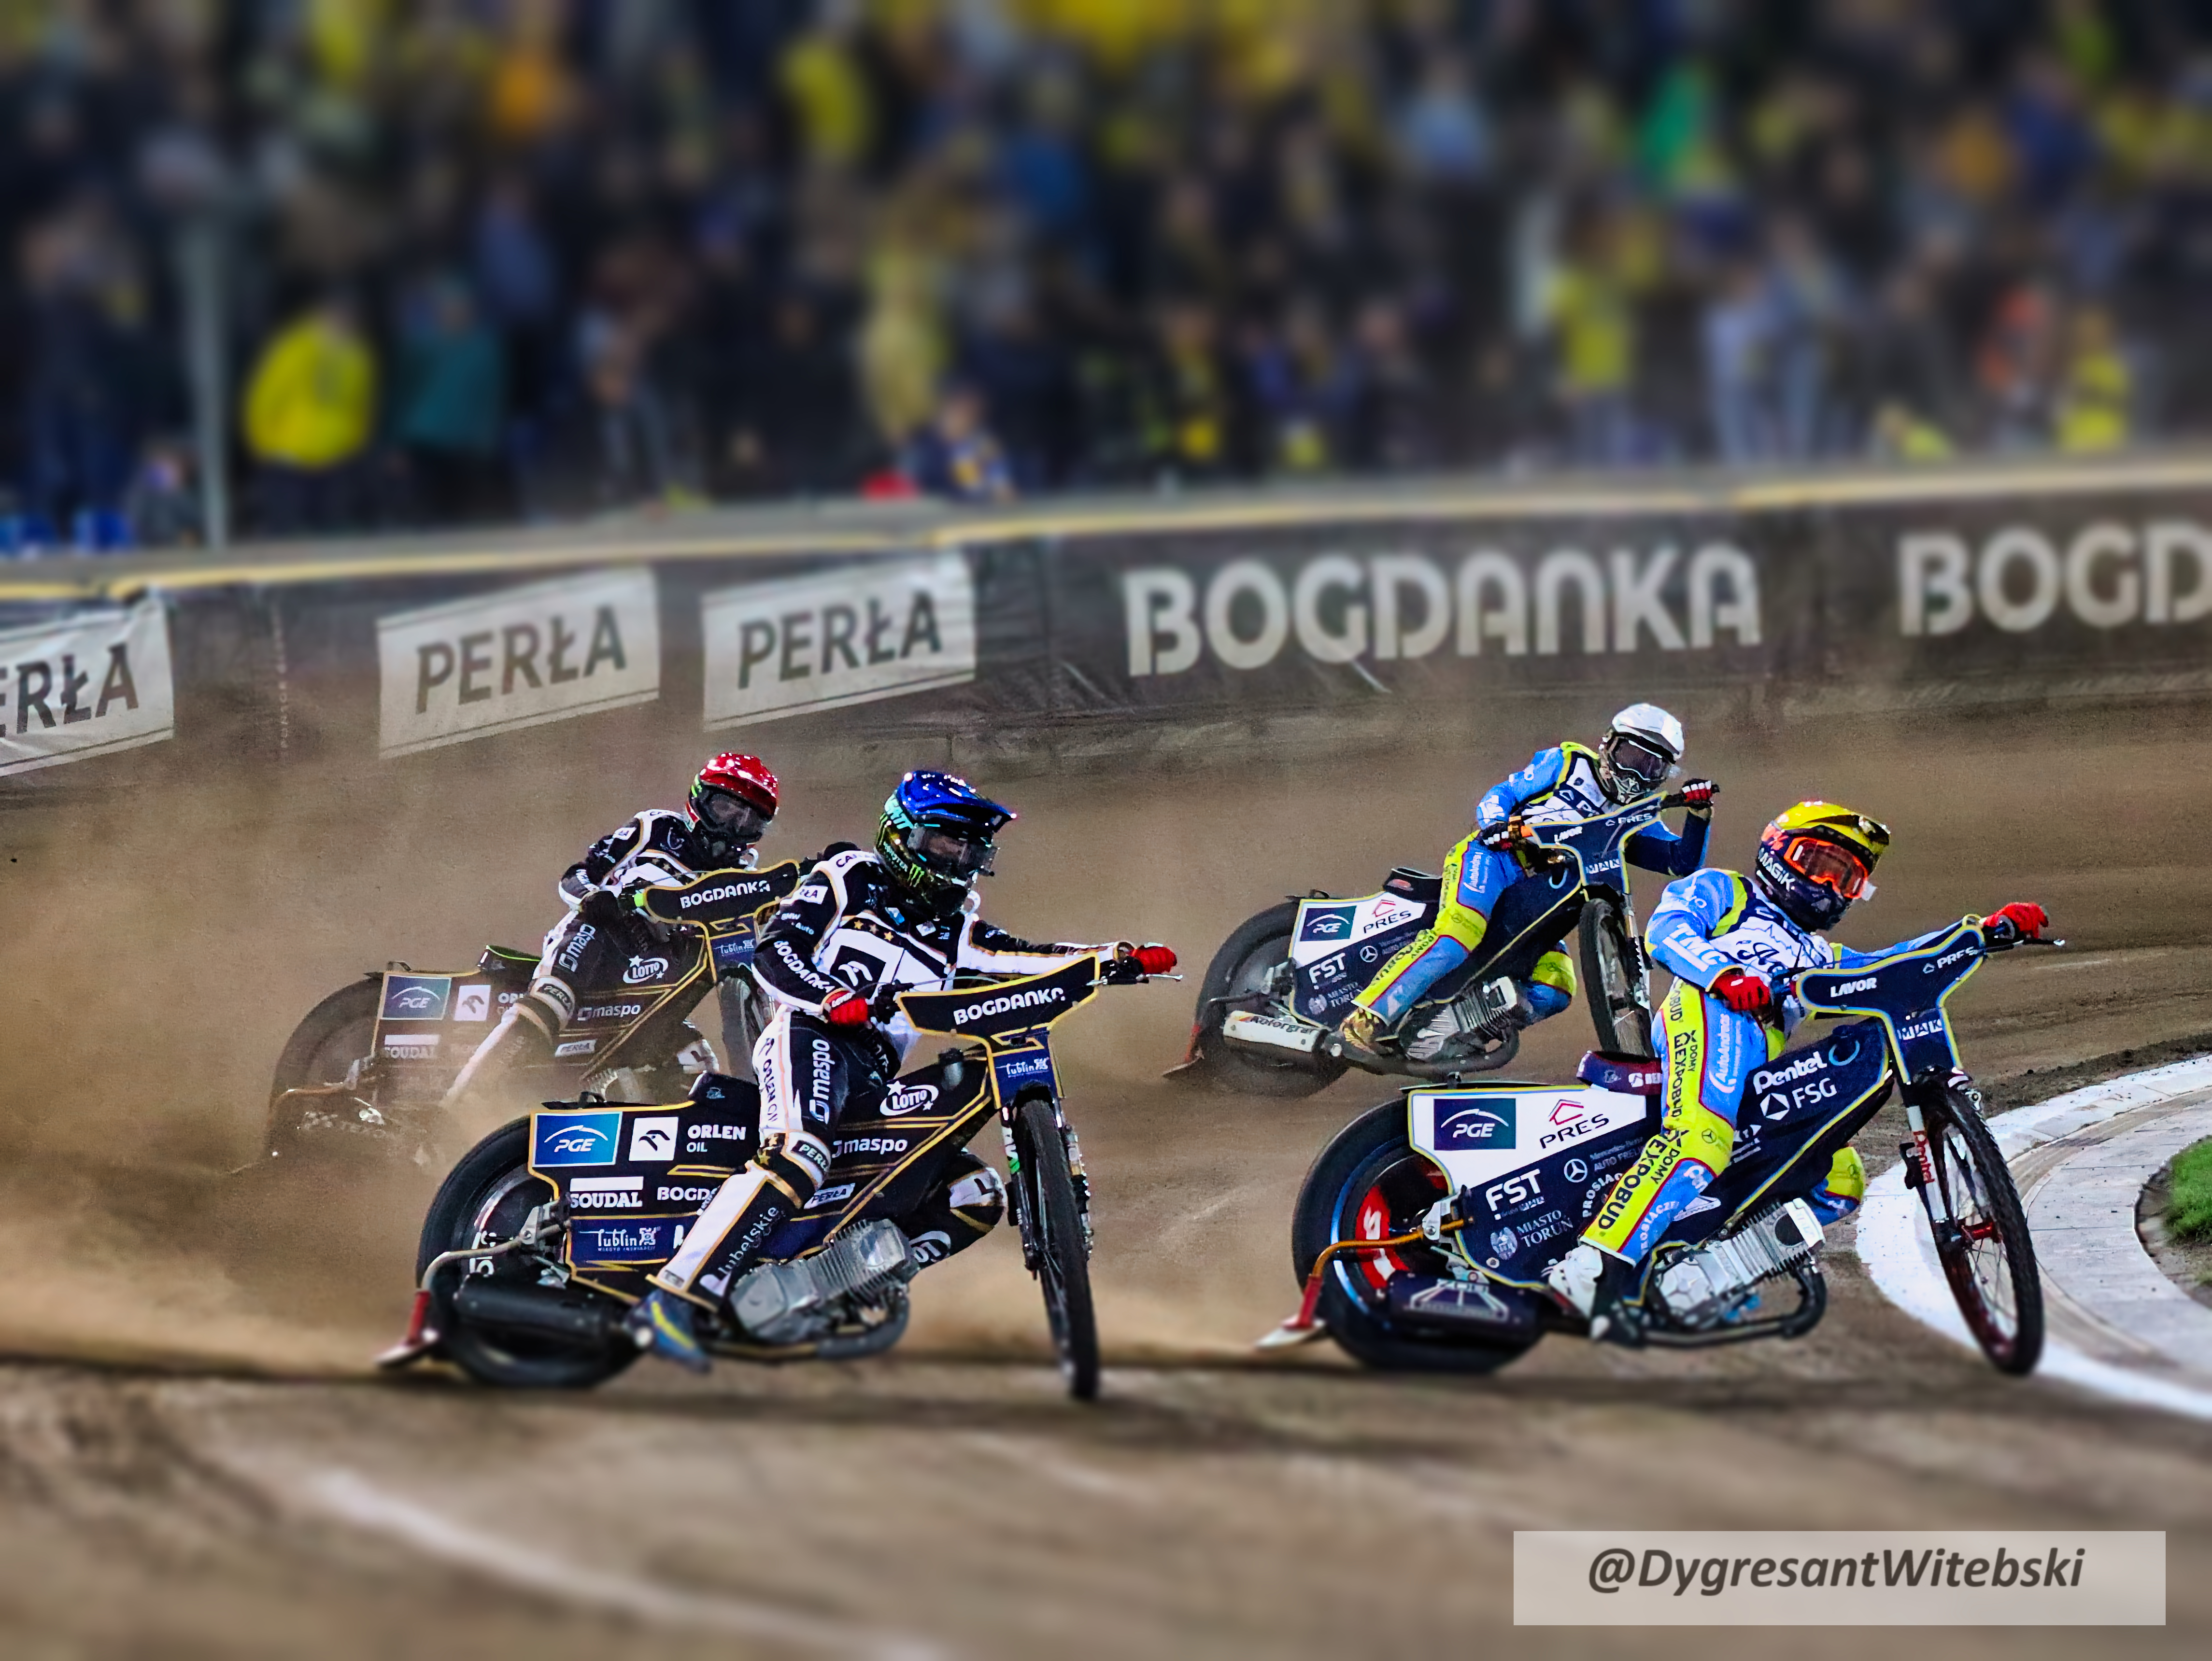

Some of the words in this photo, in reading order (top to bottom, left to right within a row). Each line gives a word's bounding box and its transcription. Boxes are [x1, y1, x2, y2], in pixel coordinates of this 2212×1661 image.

[1123, 543, 1762, 676] BOGDANKA
[737, 591, 943, 690] PERŁA
[416, 605, 627, 715] PERŁA
[0, 642, 139, 739] RŁA
[680, 880, 770, 909] BOGDANKA
[1312, 922, 1342, 933] PGE
[1363, 910, 1411, 934] PRES
[1669, 922, 1728, 965] TMC
[632, 962, 660, 979] LOTTO
[1309, 953, 1346, 984] FST
[1830, 977, 1877, 998] LAVOR
[398, 997, 431, 1009] PGE
[593, 1004, 641, 1018] maspo
[812, 1039, 836, 1101] maspo
[1753, 1051, 1828, 1095] Pentel
[892, 1090, 927, 1110] LOTTO
[1791, 1077, 1837, 1109] FSG
[687, 1125, 747, 1140] ORLEN
[1452, 1123, 1496, 1138] PGE
[1539, 1113, 1609, 1149] PRES
[554, 1138, 596, 1153] PGE
[686, 1141, 708, 1153] OIL
[843, 1139, 908, 1155] maspo
[1650, 1147, 1681, 1185] DOMY
[1486, 1168, 1541, 1212] FST
[1598, 1138, 1669, 1230] EXPOBUD
[570, 1192, 643, 1208] SOUDAL
[1516, 1210, 1561, 1234] MIASTO
